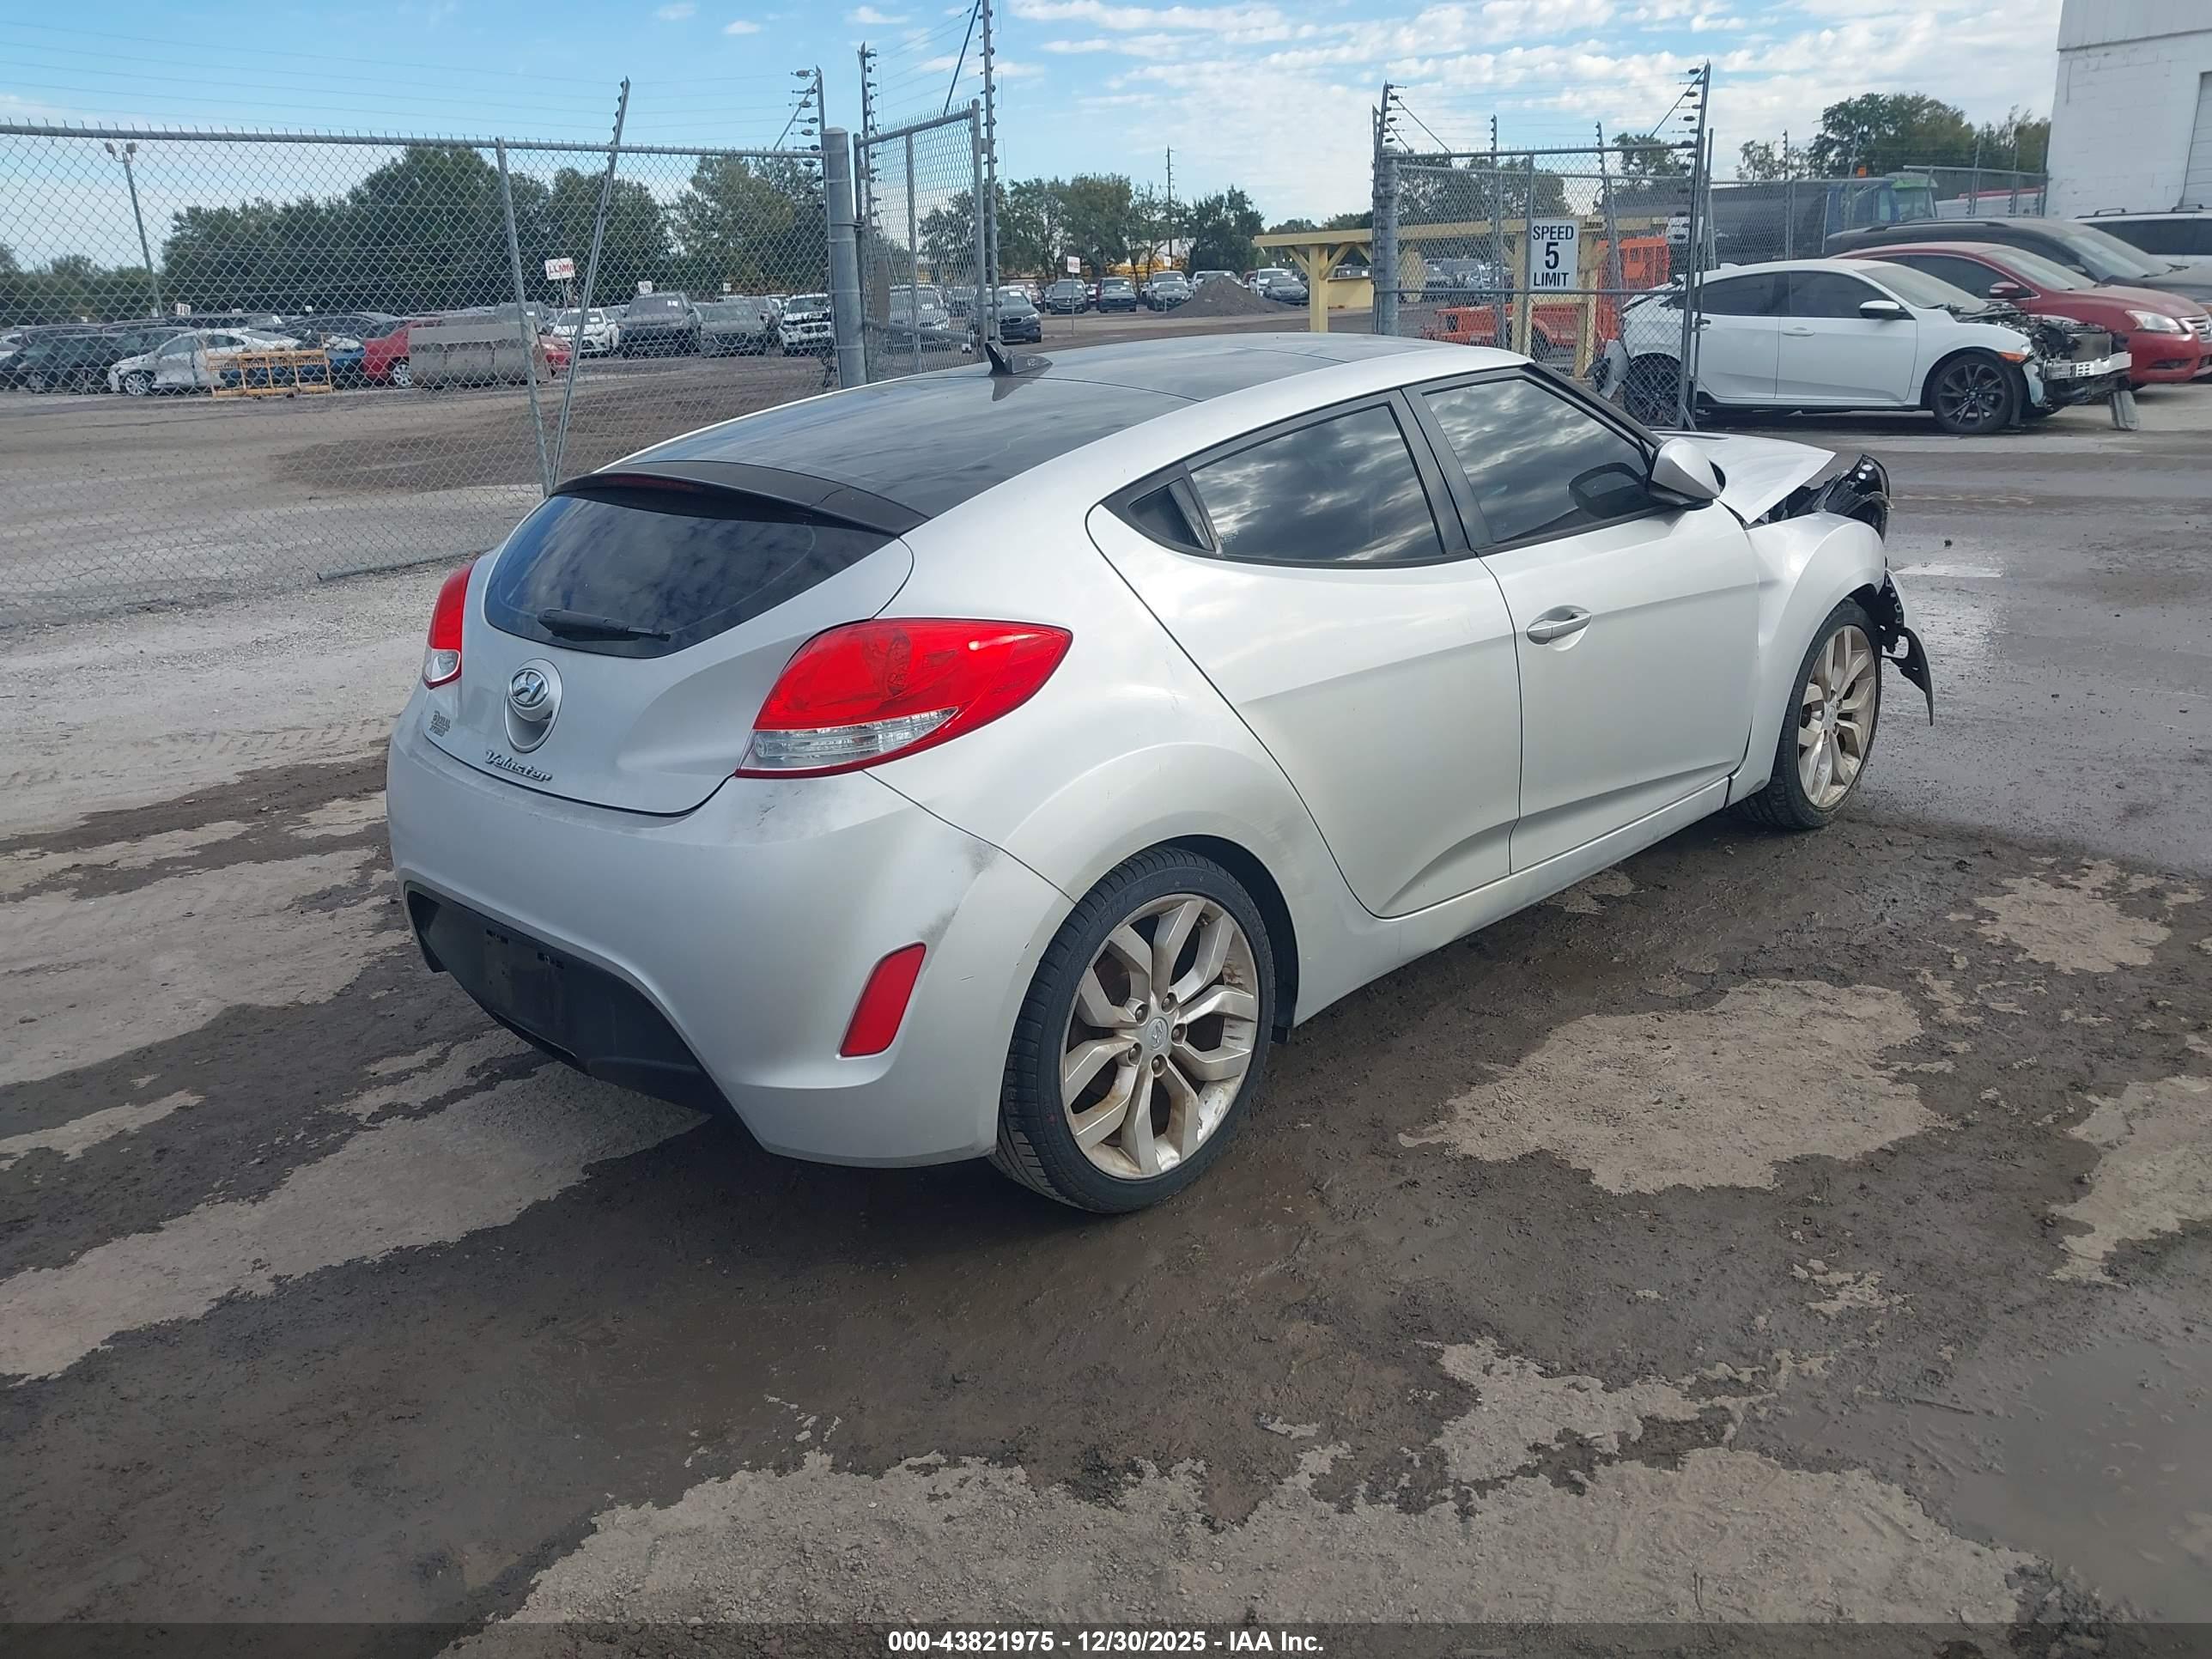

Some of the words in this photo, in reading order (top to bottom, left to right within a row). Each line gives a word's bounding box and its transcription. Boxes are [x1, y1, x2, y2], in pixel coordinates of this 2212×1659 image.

[1533, 226, 1574, 240] SPEED
[1545, 241, 1559, 270] 5
[1533, 272, 1570, 287] LIMIT
[485, 750, 553, 782] Veloster
